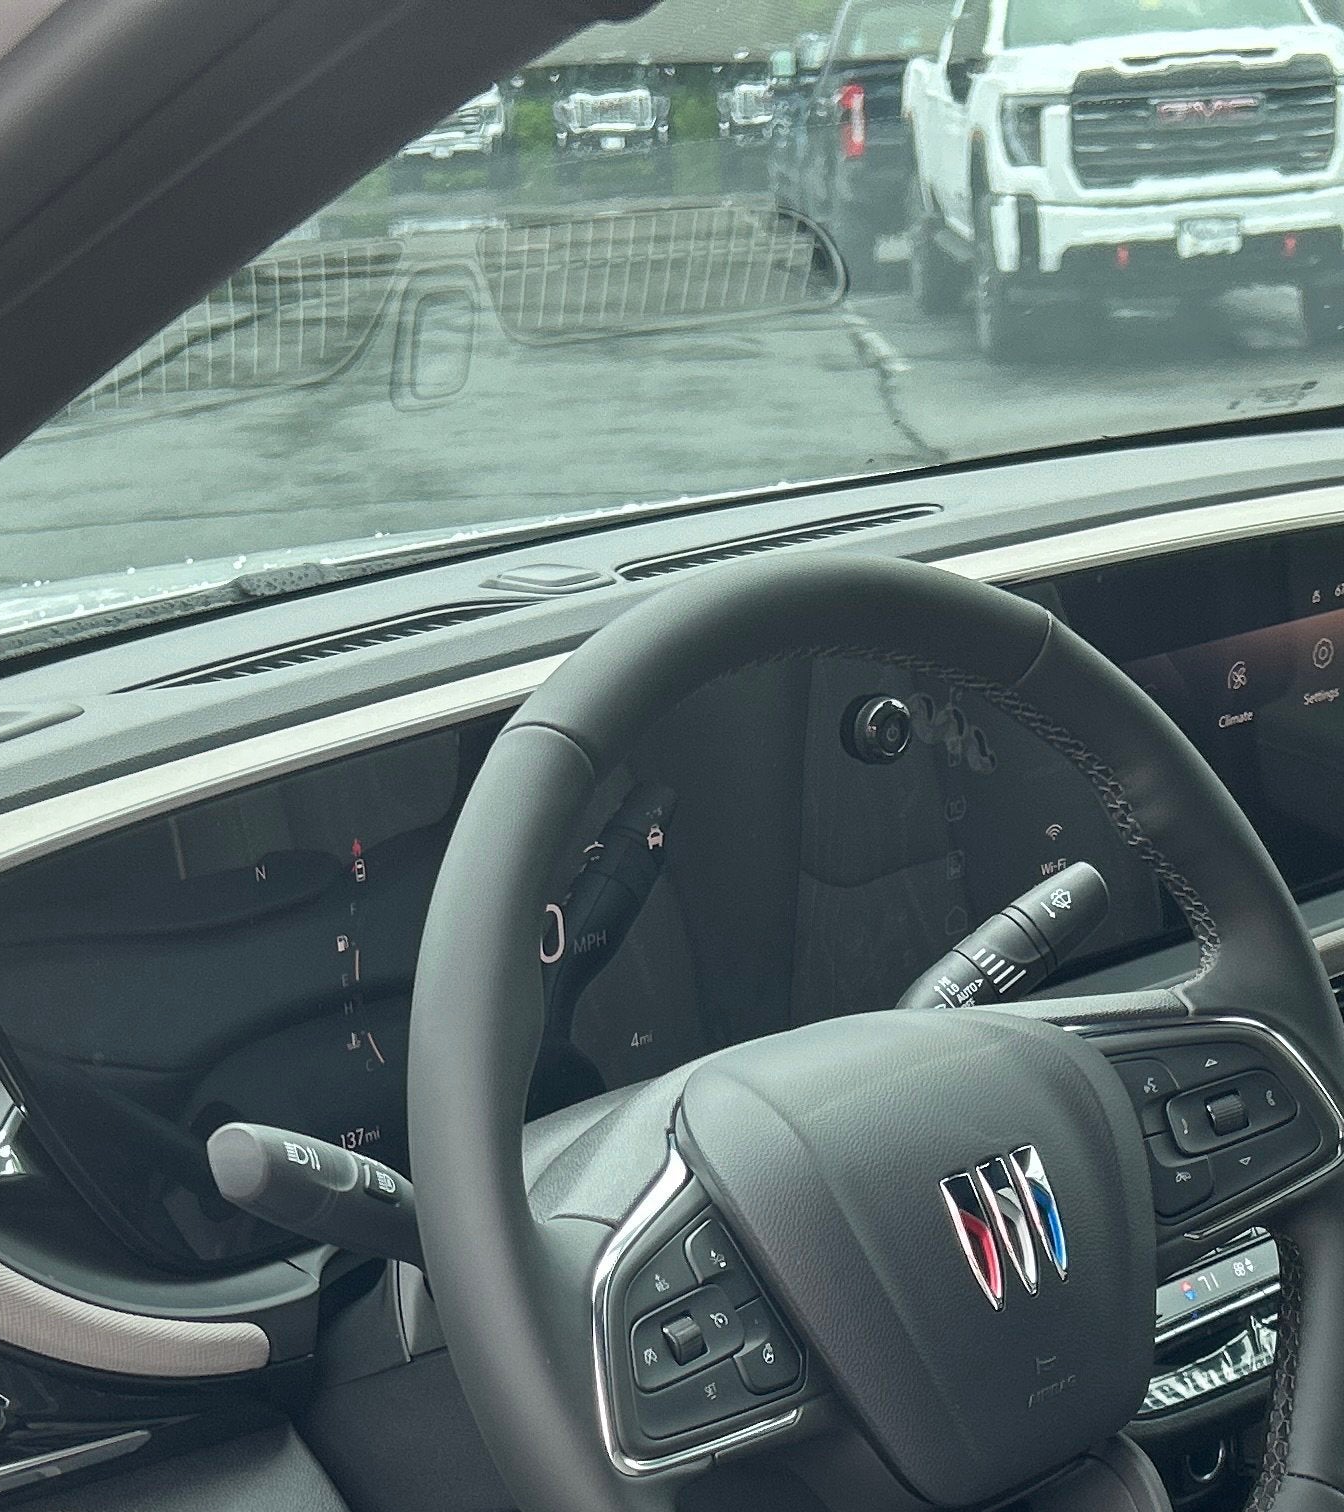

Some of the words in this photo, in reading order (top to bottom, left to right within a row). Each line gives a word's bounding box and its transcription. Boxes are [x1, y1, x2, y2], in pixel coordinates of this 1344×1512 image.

[1303, 687, 1341, 706] Settings
[1218, 711, 1254, 728] Climate
[255, 865, 267, 882] N
[1040, 858, 1067, 876] Wi-Fi
[574, 929, 607, 954] MPH
[956, 982, 978, 1004] AUTO
